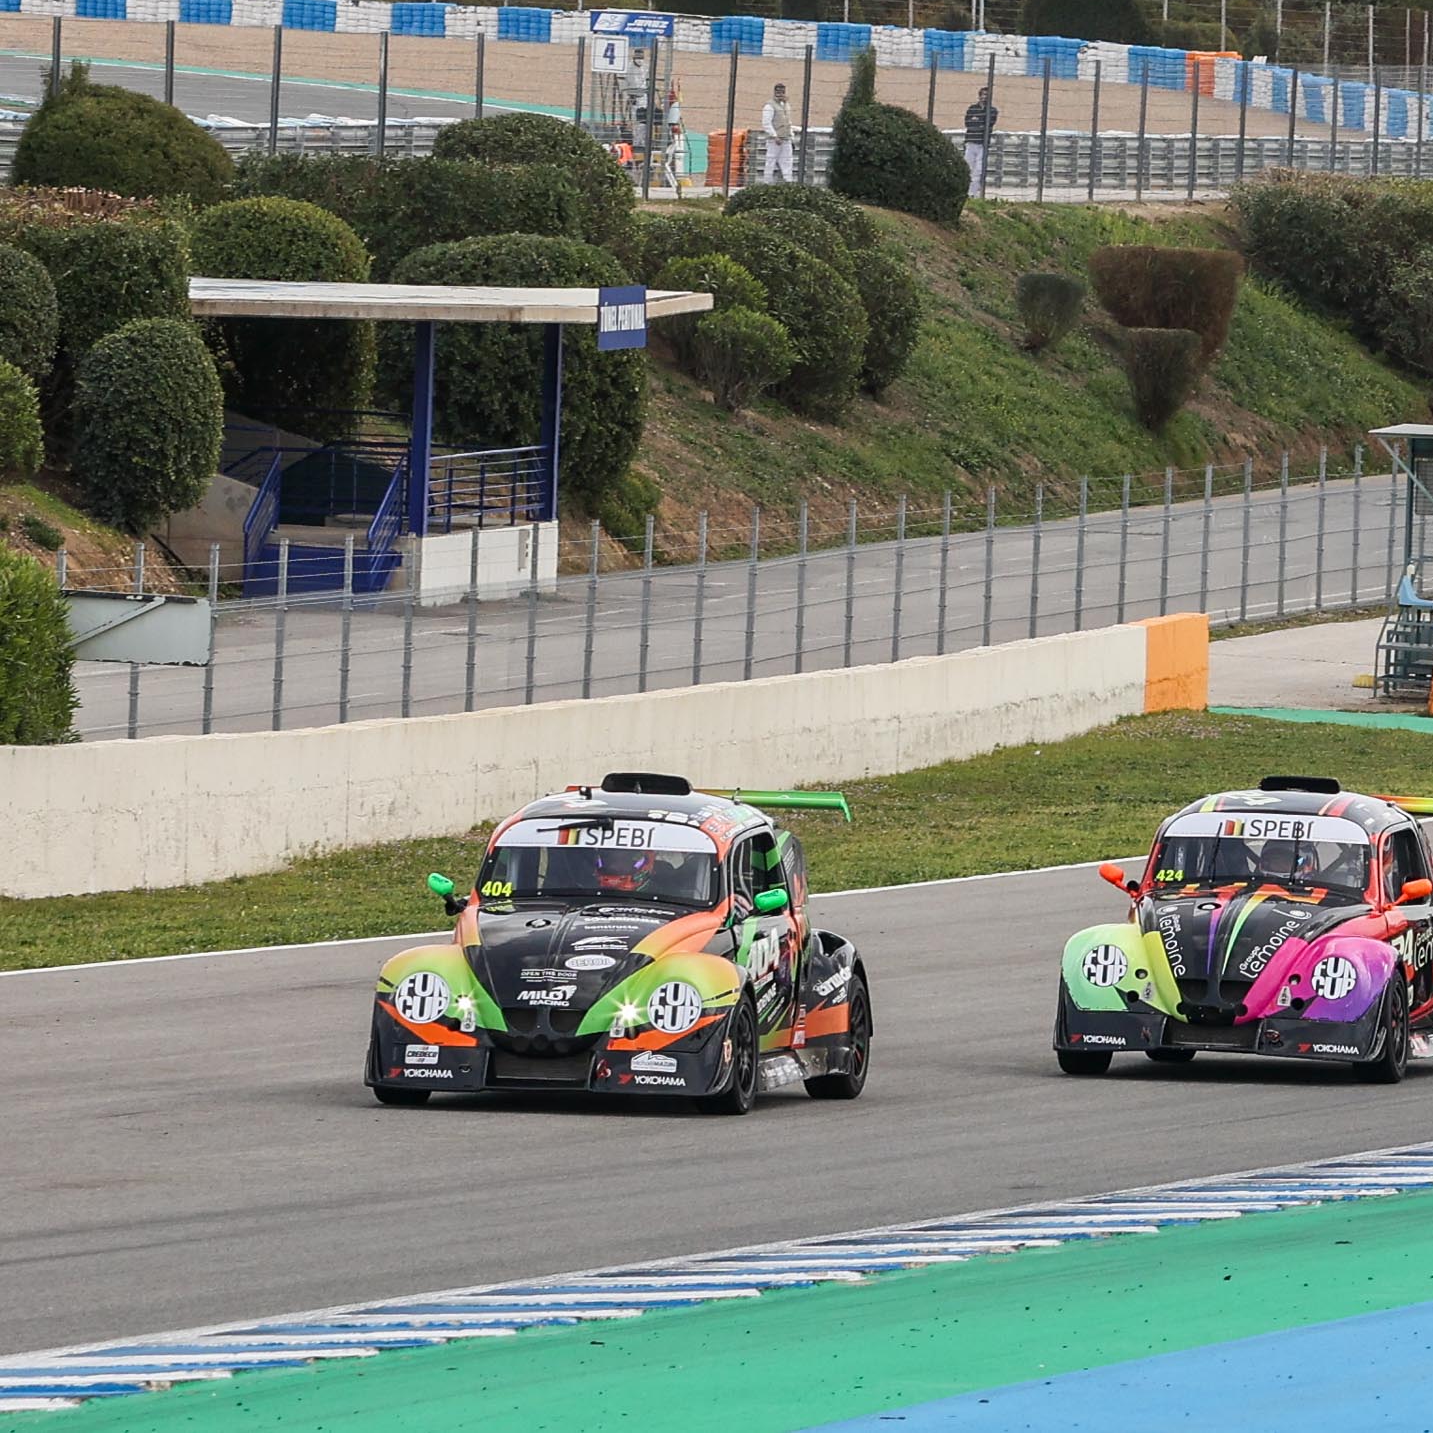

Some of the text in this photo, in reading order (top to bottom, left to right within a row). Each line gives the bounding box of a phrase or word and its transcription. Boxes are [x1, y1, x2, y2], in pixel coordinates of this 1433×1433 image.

[602, 42, 616, 66] 4
[1156, 869, 1185, 882] 424
[481, 881, 513, 897] 404
[1084, 945, 1127, 966] FUN
[1083, 965, 1128, 986] CUP
[1314, 957, 1357, 978] FUN
[401, 973, 447, 997] FUN
[651, 983, 698, 1006] FUN
[1311, 977, 1357, 1000] CUP
[398, 996, 449, 1021] CUP
[650, 1005, 699, 1031] CUP
[1083, 1034, 1127, 1046] YOKOHAMA
[1312, 1043, 1360, 1055] YOKOHAMA
[403, 1068, 454, 1078] YOKOHAMA
[634, 1075, 686, 1087] YOKOHAMA
